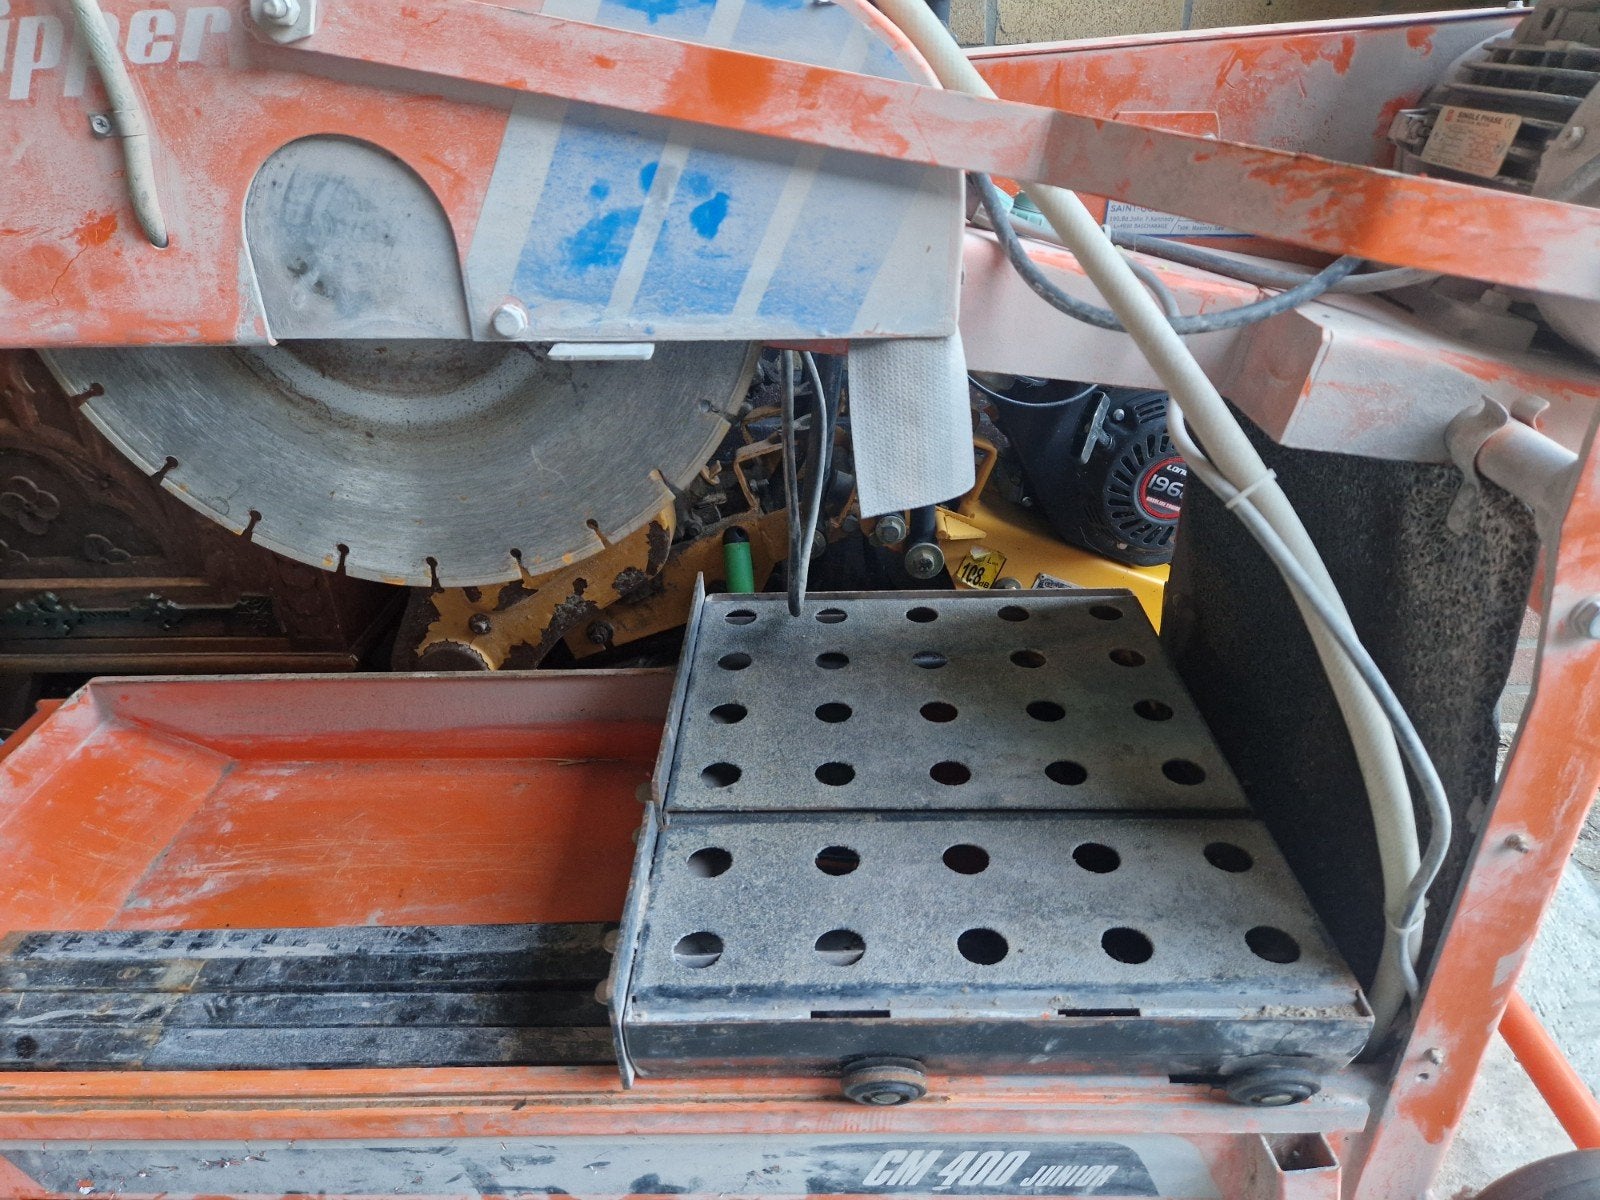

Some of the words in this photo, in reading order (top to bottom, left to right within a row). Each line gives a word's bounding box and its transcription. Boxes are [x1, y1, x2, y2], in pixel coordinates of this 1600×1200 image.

[862, 1149, 944, 1186] CM
[932, 1150, 1031, 1191] 400
[1019, 1165, 1119, 1187] JUNIOR
